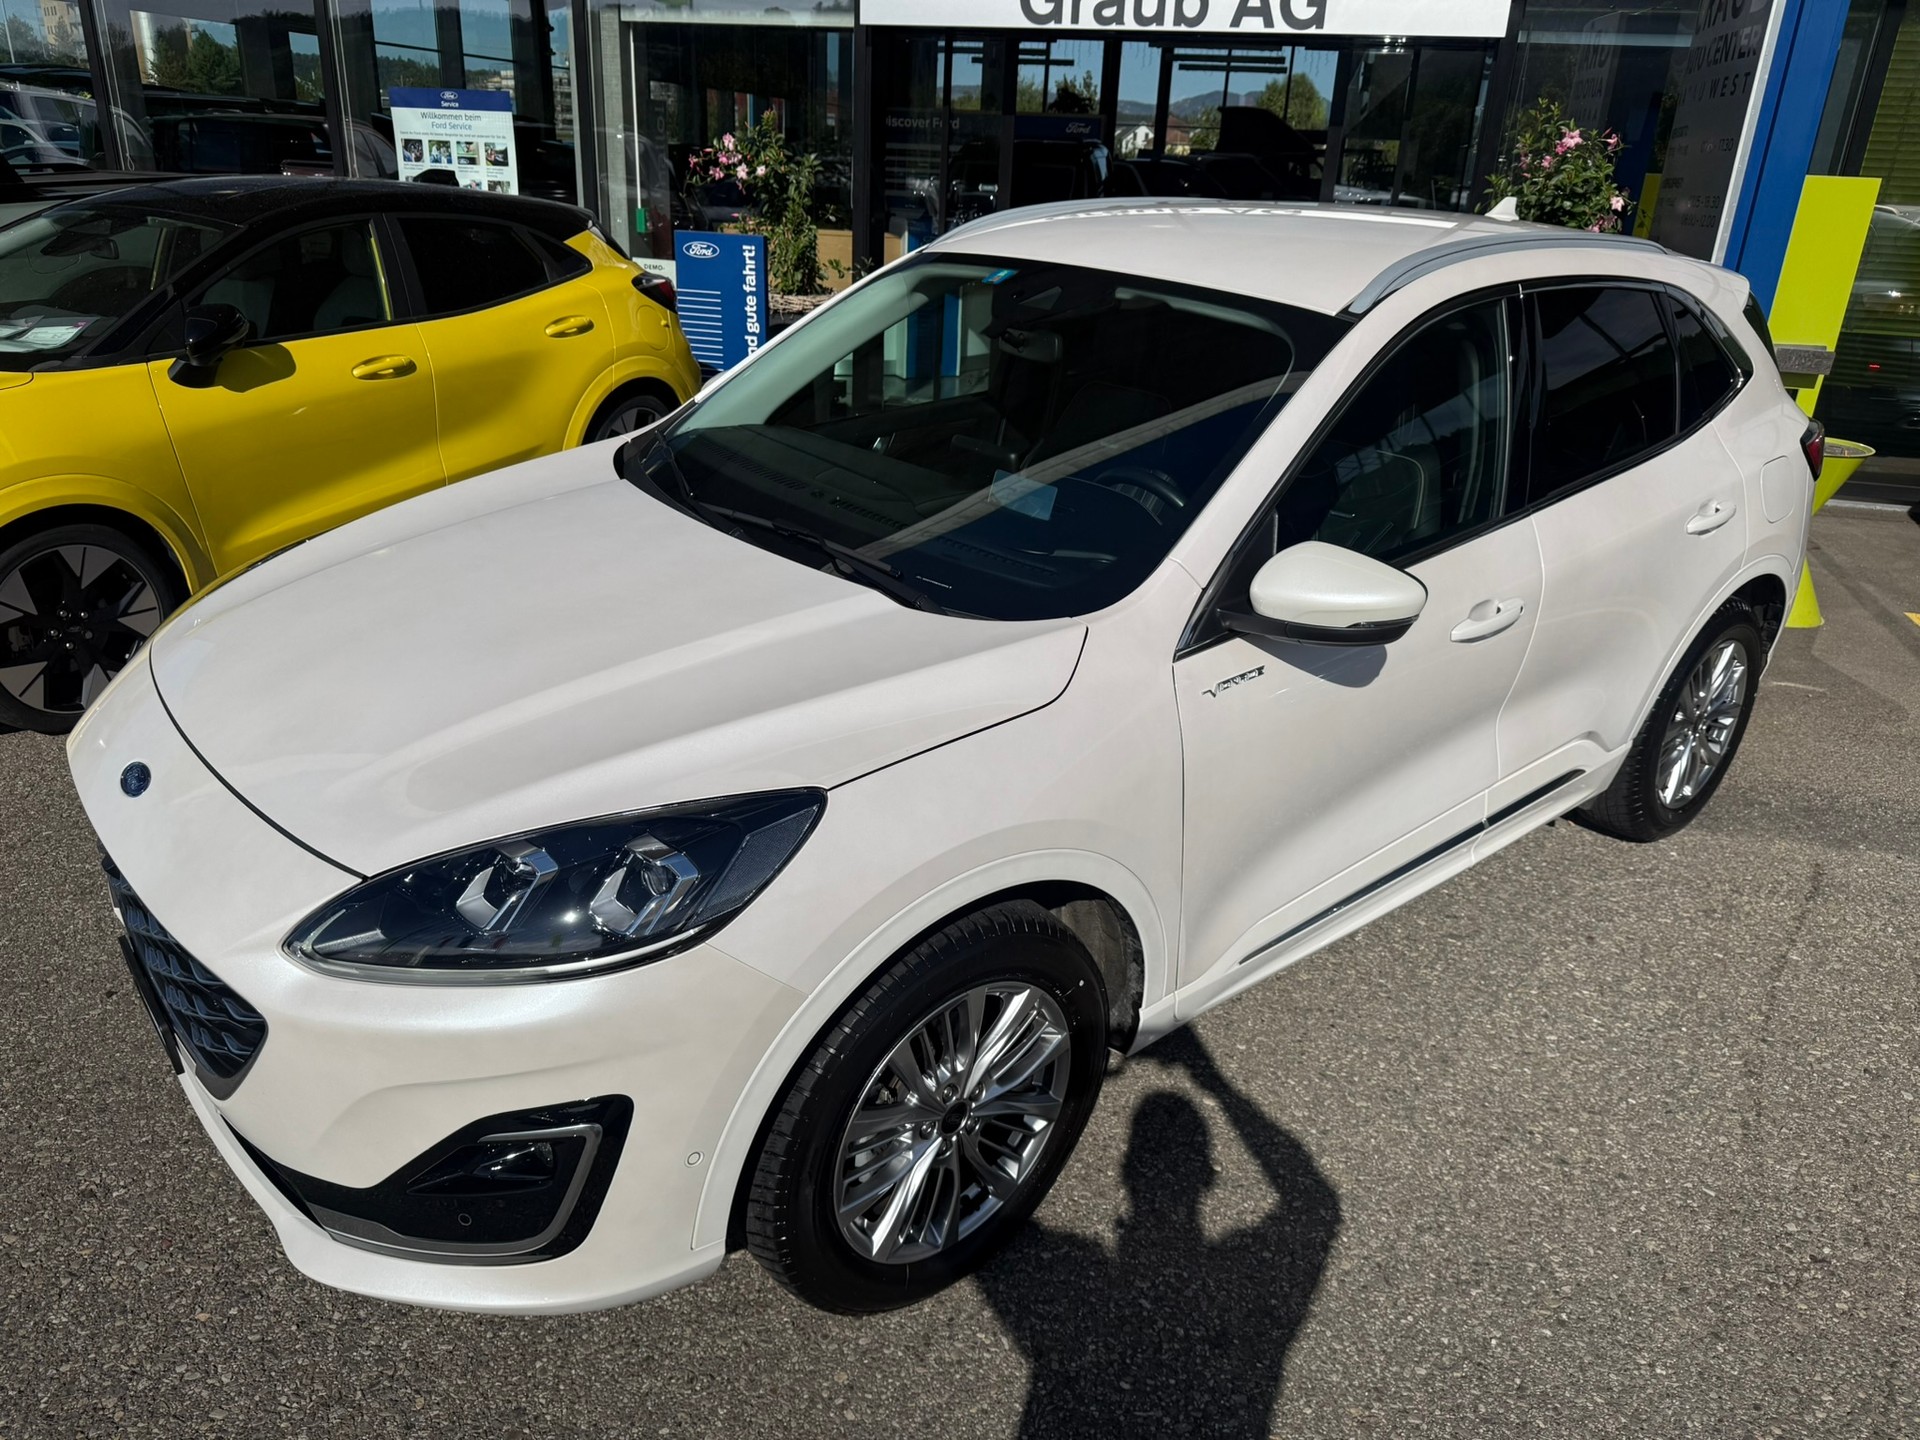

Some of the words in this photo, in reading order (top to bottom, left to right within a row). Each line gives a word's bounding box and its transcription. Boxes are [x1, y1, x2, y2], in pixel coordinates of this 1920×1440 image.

[1229, 0, 1326, 30] AG
[1710, 72, 1751, 99] WEST
[420, 112, 463, 120] Willkommen
[886, 115, 931, 129] iscover
[932, 117, 960, 129] Fd
[449, 122, 472, 130] Service
[1065, 119, 1091, 134] Ford
[687, 242, 715, 257] Ford
[643, 263, 666, 271] DEMO-
[742, 244, 756, 294] fahrt!
[744, 295, 760, 334] gute
